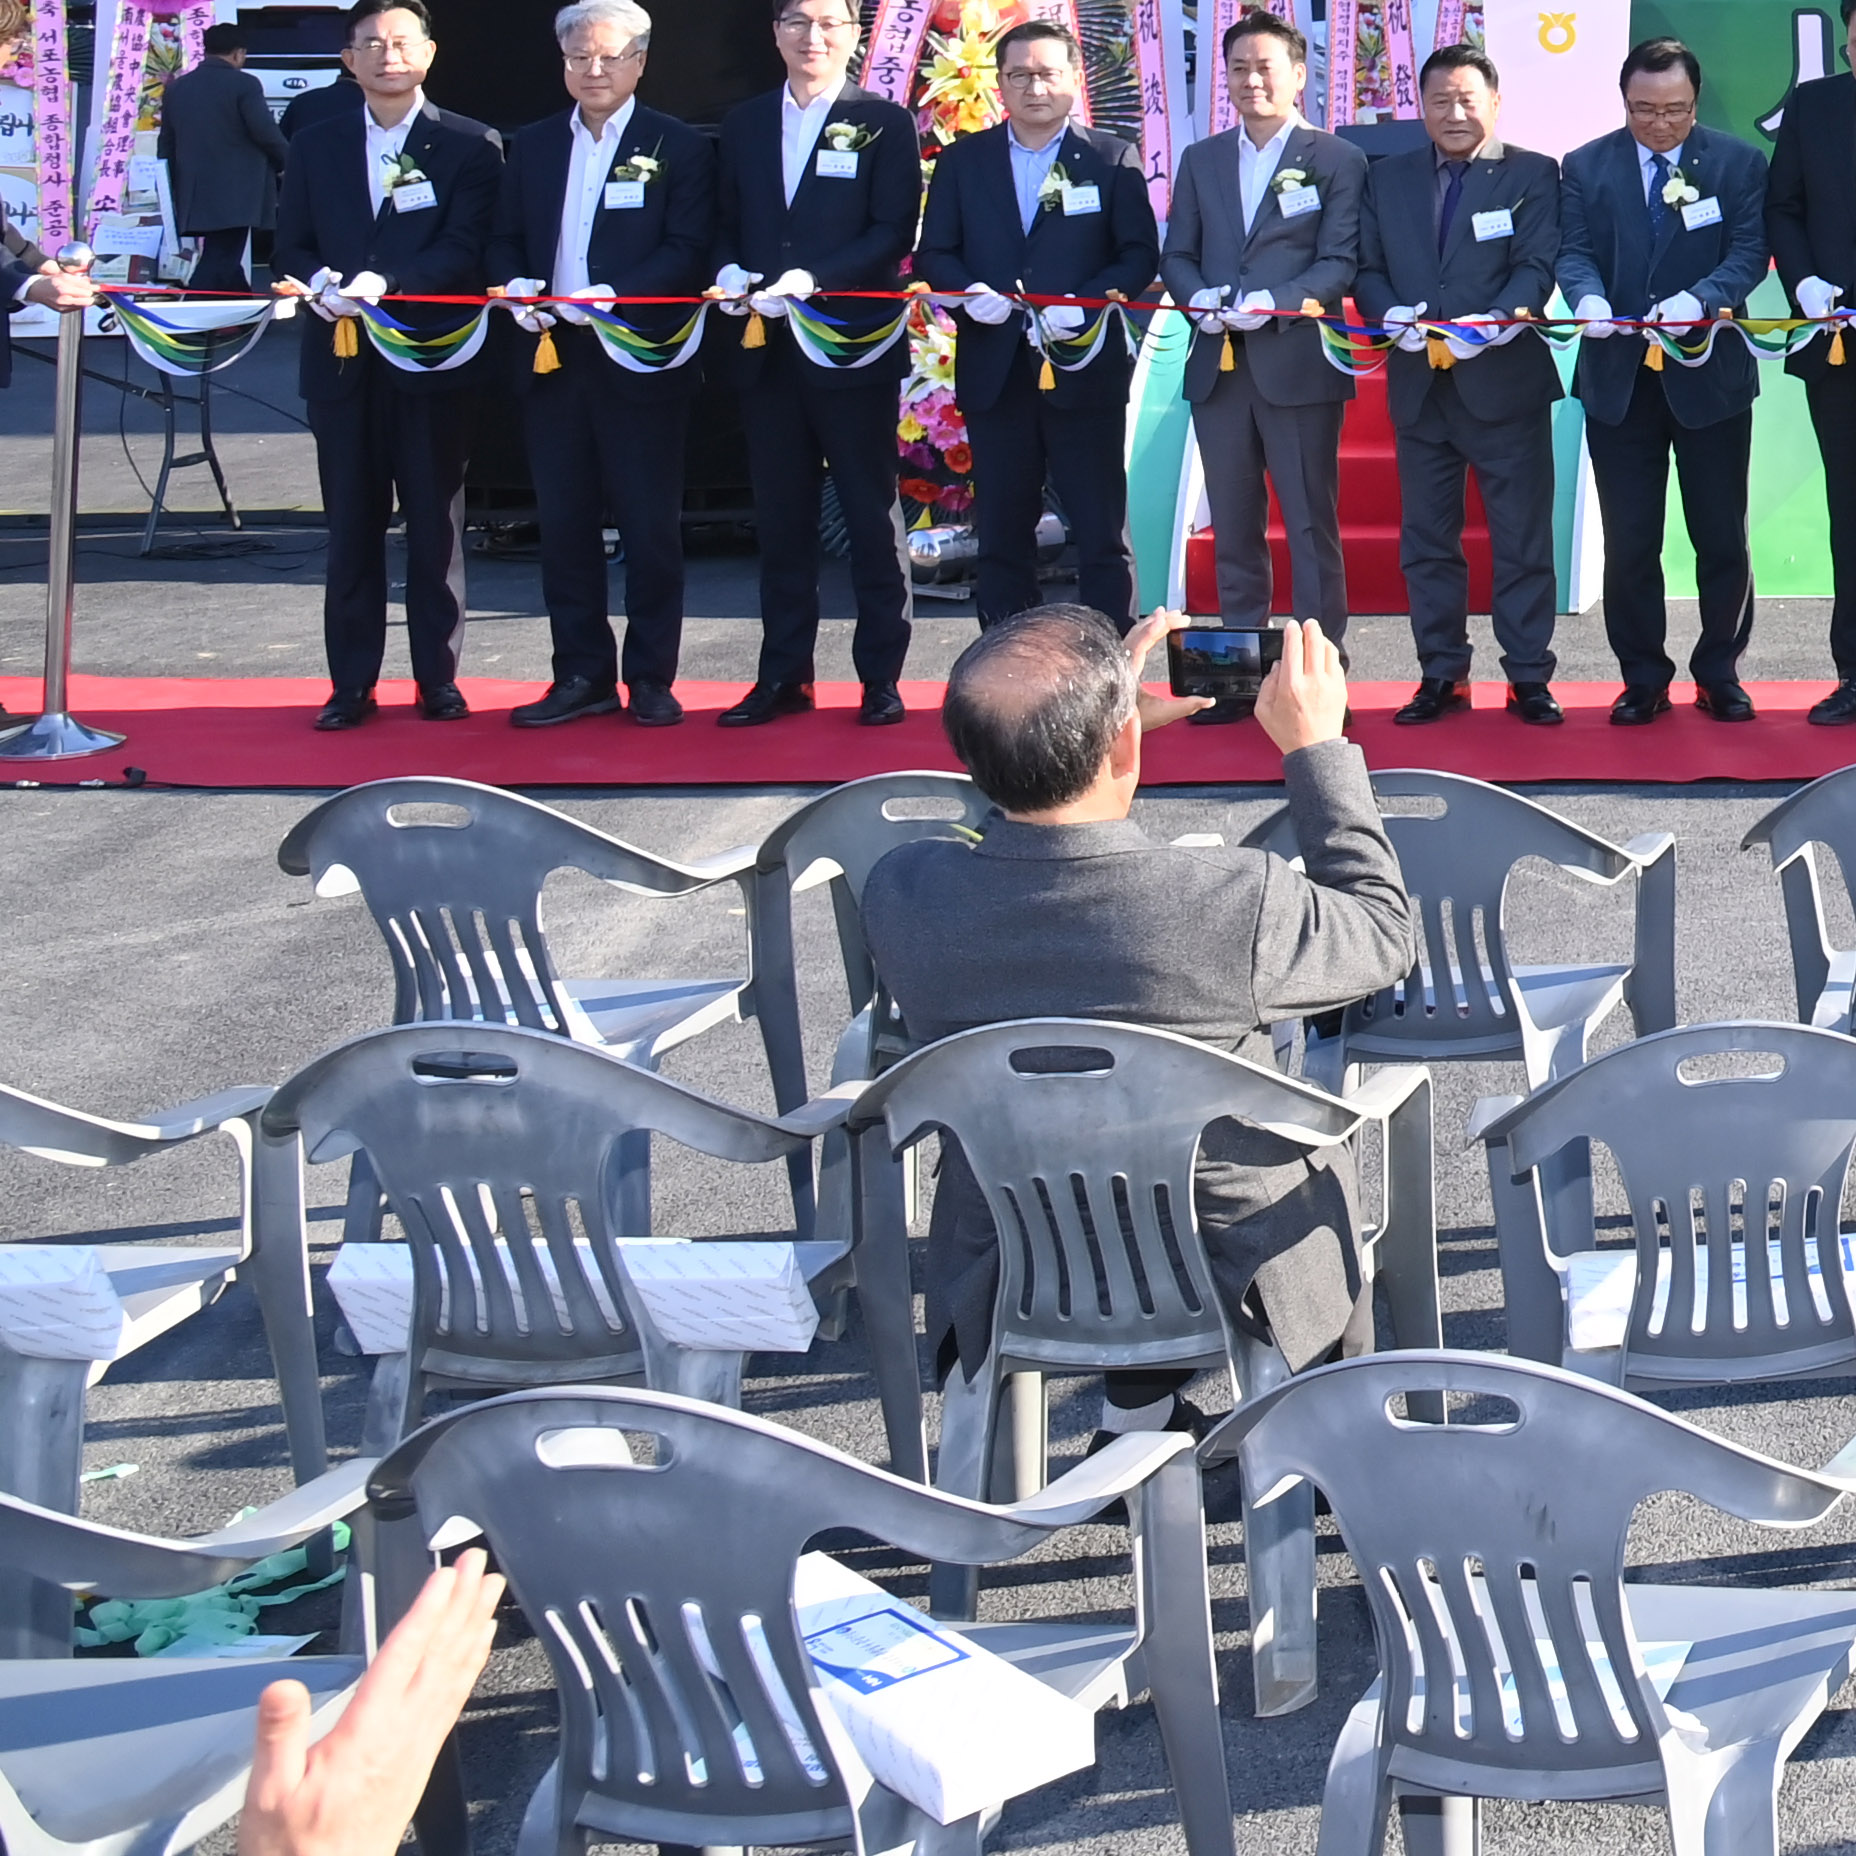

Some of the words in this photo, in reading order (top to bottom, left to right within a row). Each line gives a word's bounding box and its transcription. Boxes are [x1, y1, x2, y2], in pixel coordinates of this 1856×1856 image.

[38, 29, 63, 104] 서포농협
[285, 79, 307, 88] KIA
[40, 113, 69, 188] 종합청사
[42, 199, 69, 238] 준공
